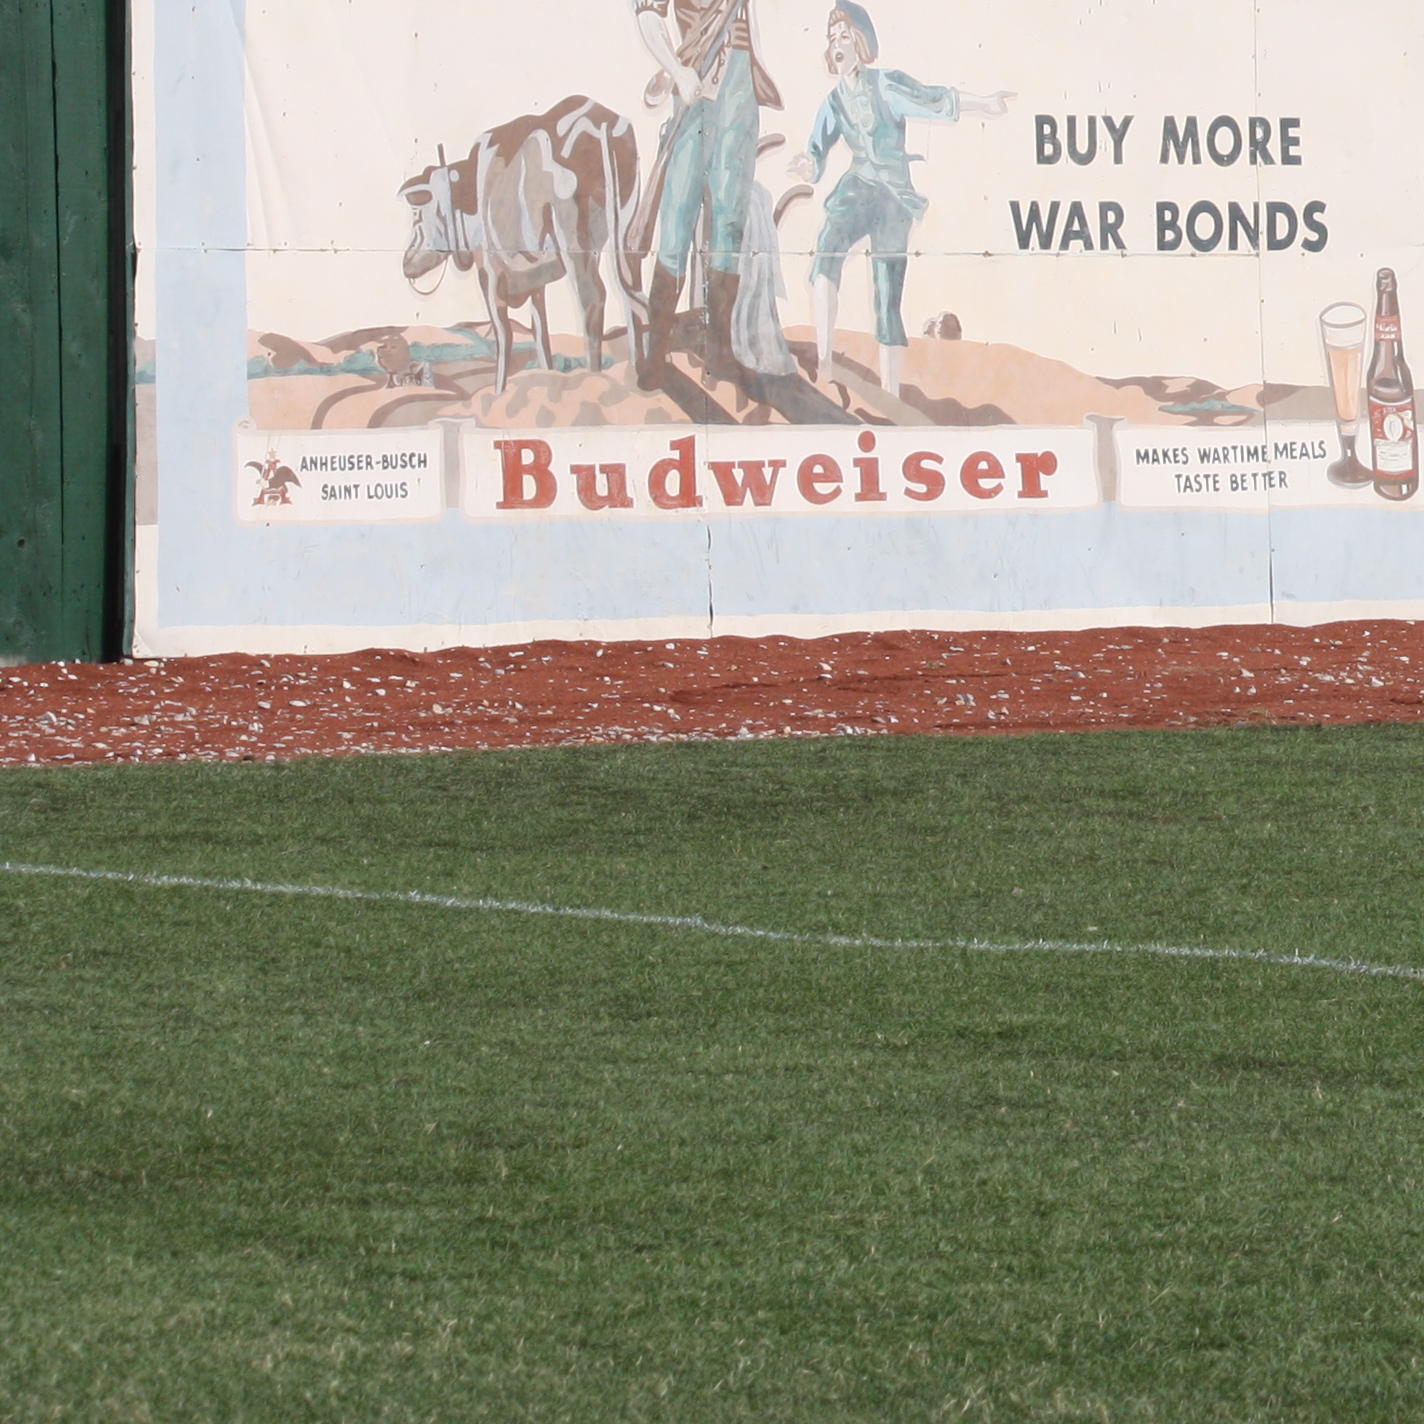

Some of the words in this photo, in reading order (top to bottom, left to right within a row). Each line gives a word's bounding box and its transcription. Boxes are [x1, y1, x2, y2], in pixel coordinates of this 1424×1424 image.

[1036, 115, 1132, 165] BUY
[1160, 116, 1301, 166] MORE
[1010, 201, 1125, 250] WAR
[1157, 201, 1327, 252] BONDS
[299, 451, 429, 472] ANHEUSER-BUSCH
[1136, 447, 1189, 465] MAKES
[1198, 445, 1267, 464] WARTIME
[1274, 440, 1326, 459] MEALS
[493, 430, 1059, 511] Budweiser
[1175, 474, 1219, 493] TASTE
[1230, 471, 1287, 492] BETTER
[320, 483, 361, 500] SAINT
[366, 481, 409, 499] LOUIS
